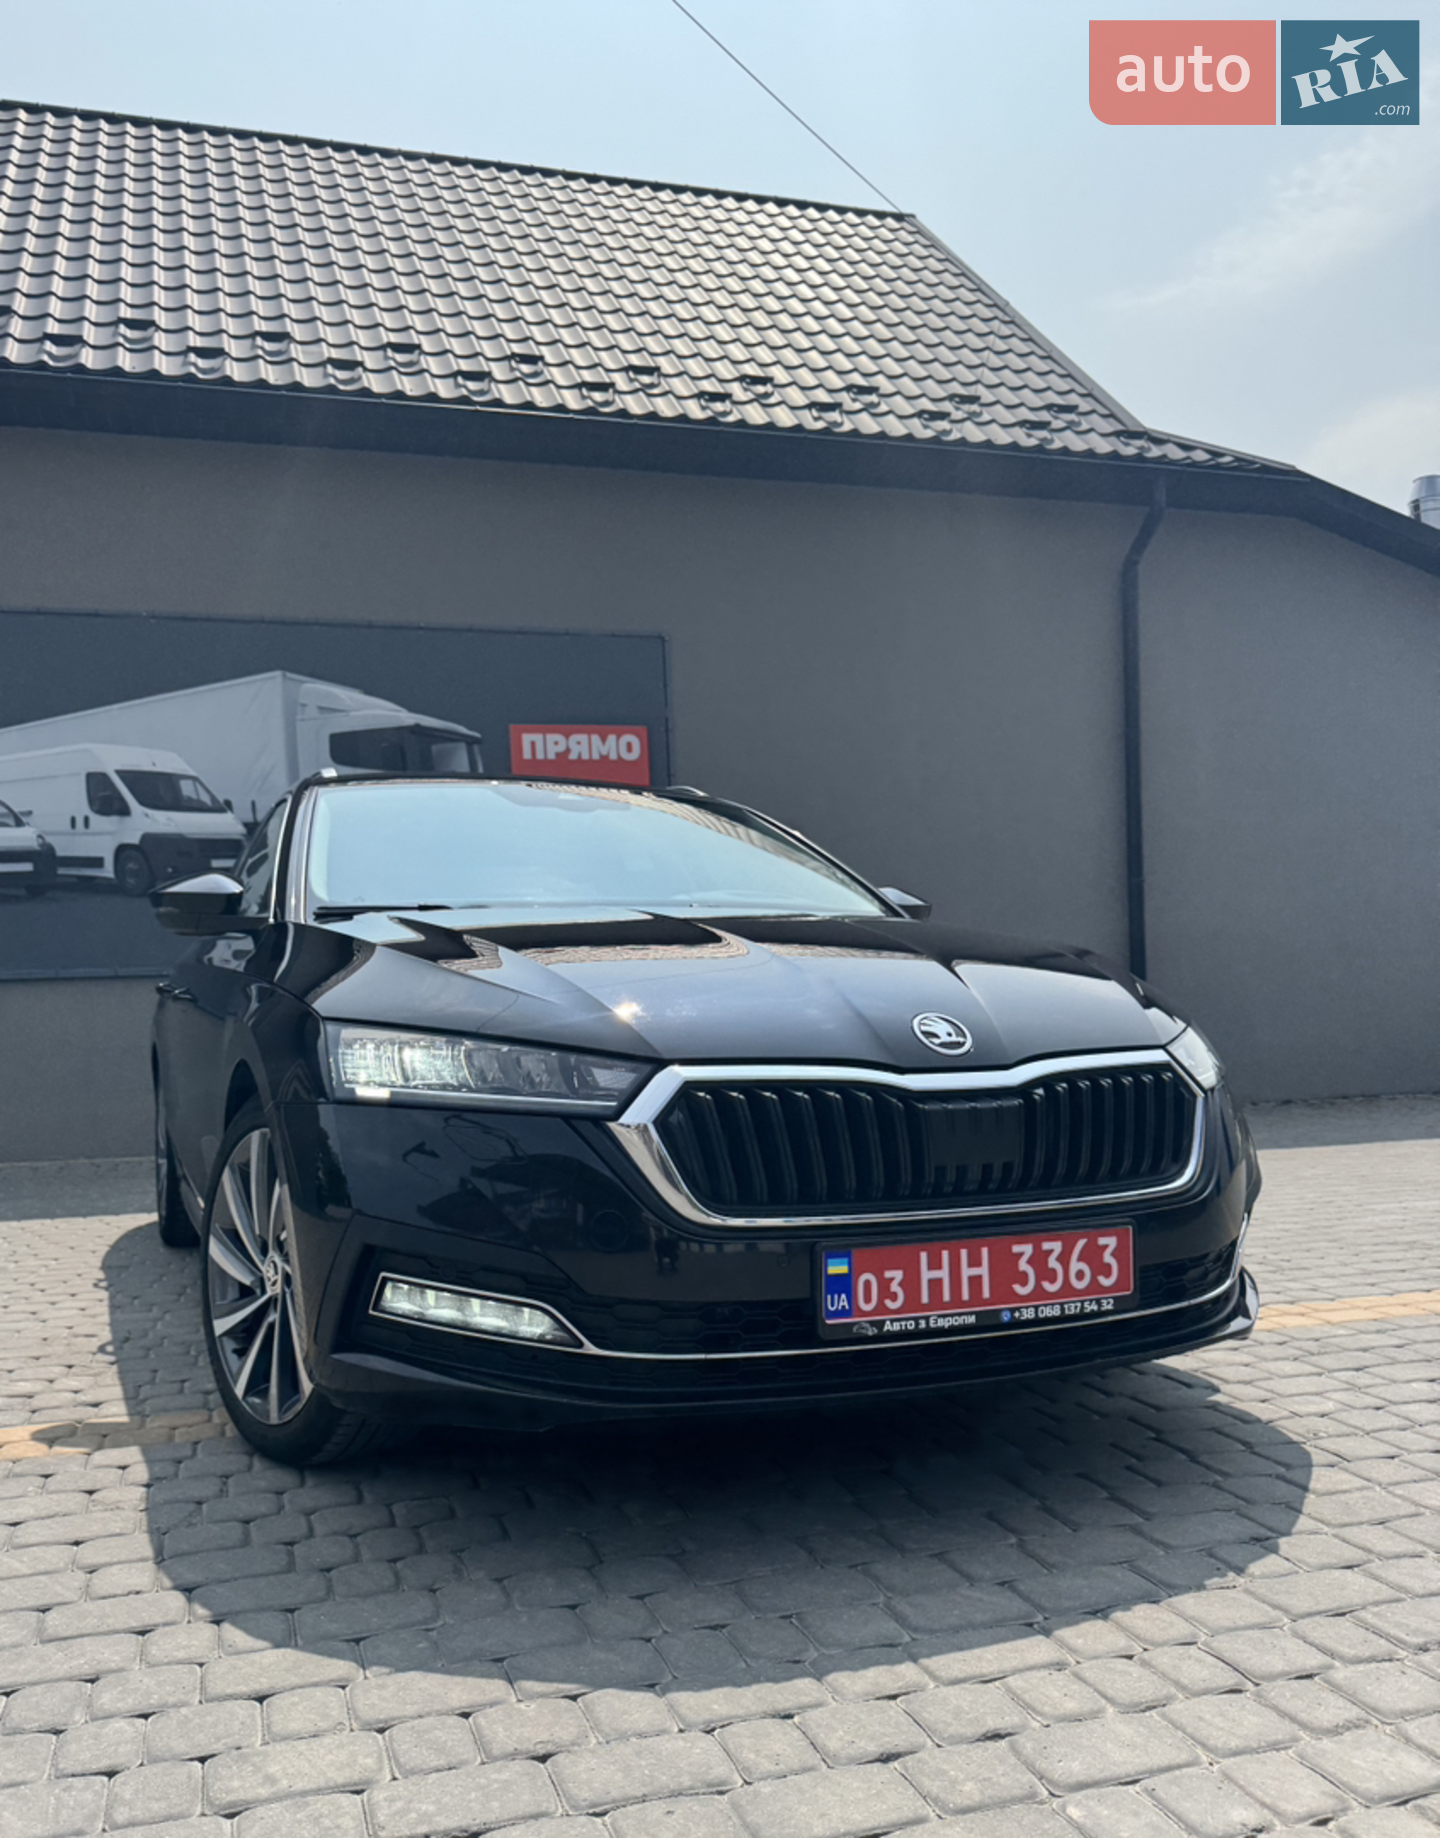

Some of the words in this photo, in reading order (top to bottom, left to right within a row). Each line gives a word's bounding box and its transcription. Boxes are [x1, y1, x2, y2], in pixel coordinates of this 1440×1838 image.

[521, 732, 641, 762] ПРЯМО
[857, 1269, 905, 1312] 03
[1011, 1235, 1119, 1296] 3363
[826, 1294, 850, 1312] UA
[1013, 1307, 1035, 1320] +38
[1038, 1304, 1061, 1318] 068
[1063, 1302, 1081, 1315] 137
[1083, 1300, 1098, 1312] 54
[1100, 1298, 1114, 1310] 32
[883, 1319, 915, 1332] Авто
[928, 1313, 976, 1329] Європи
